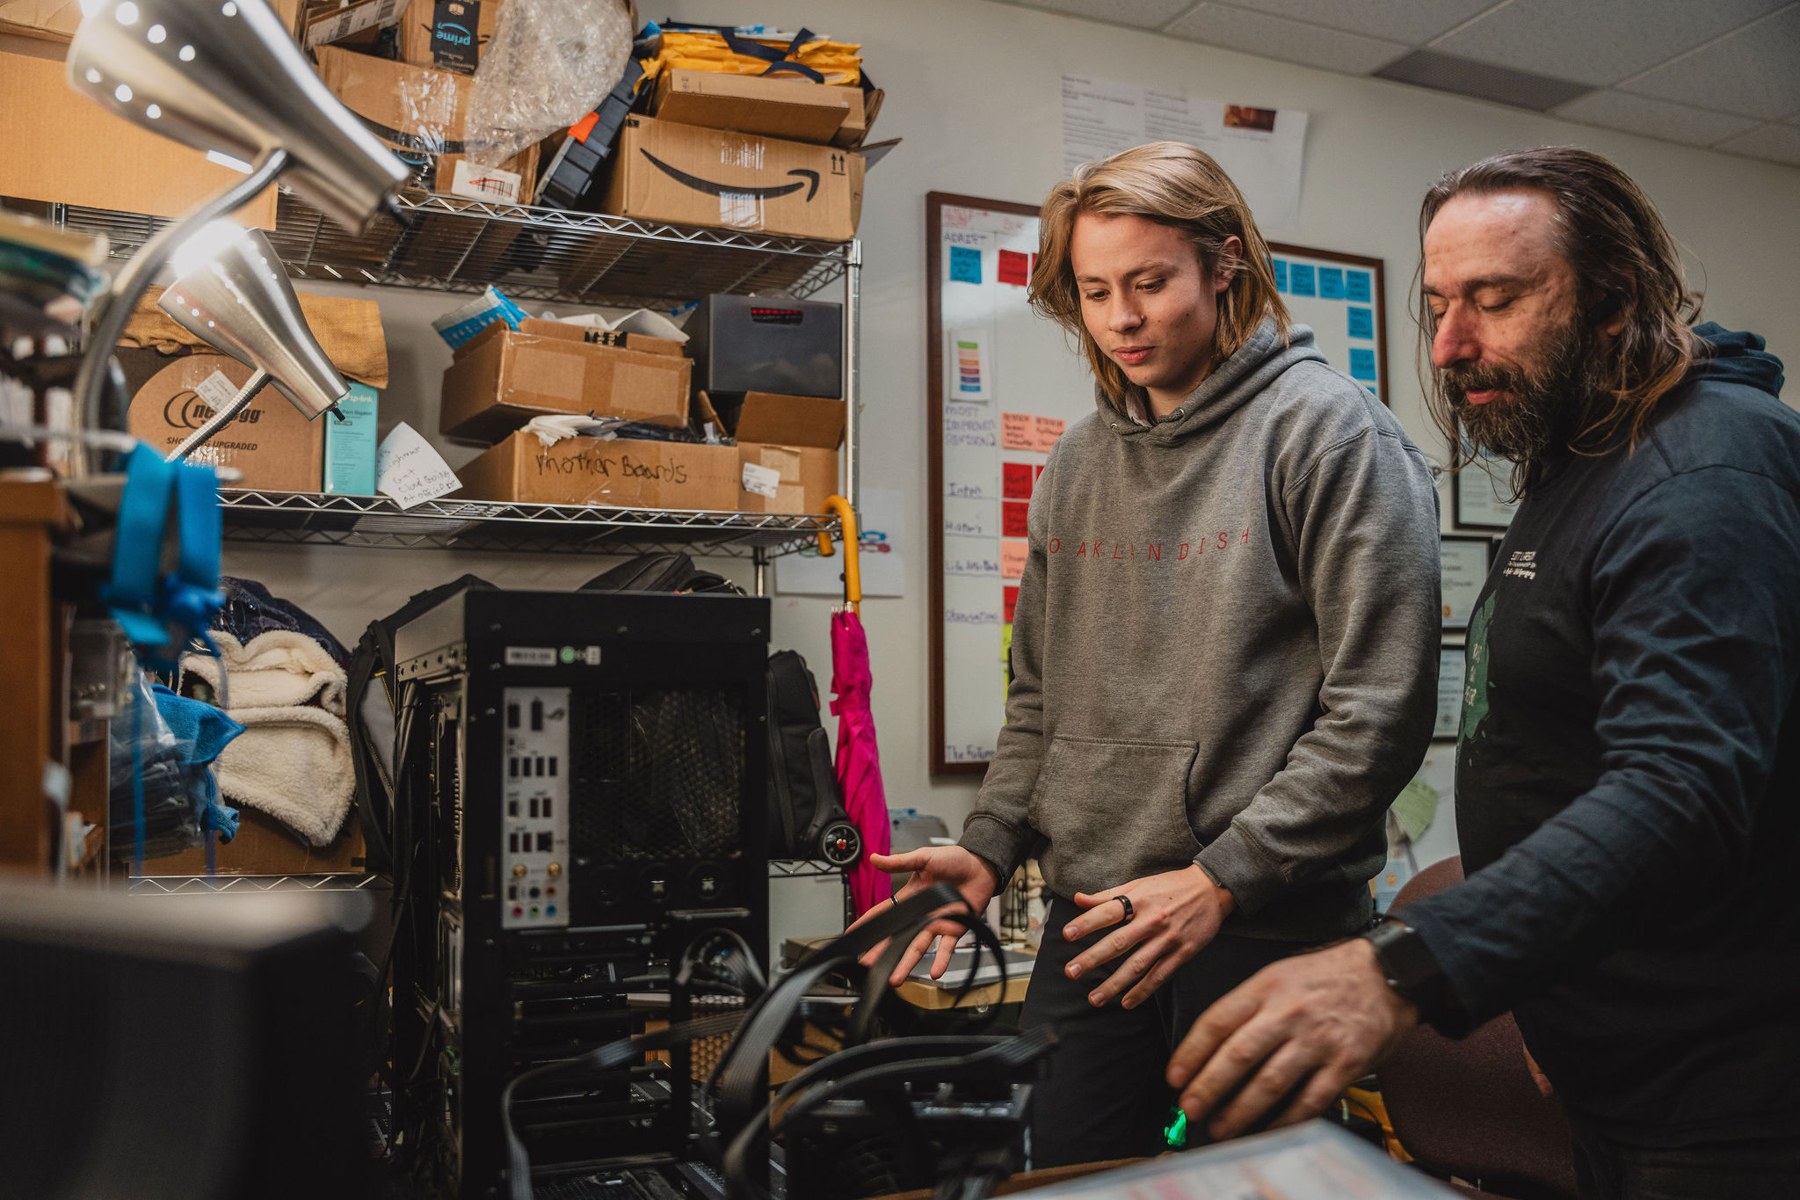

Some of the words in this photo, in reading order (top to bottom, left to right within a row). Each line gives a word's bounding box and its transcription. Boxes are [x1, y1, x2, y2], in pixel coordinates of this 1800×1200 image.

[436, 31, 471, 46] prime
[192, 403, 261, 424] negg
[166, 437, 211, 448] SHOG
[212, 440, 258, 451] UPGRADED
[622, 455, 687, 484] Boards
